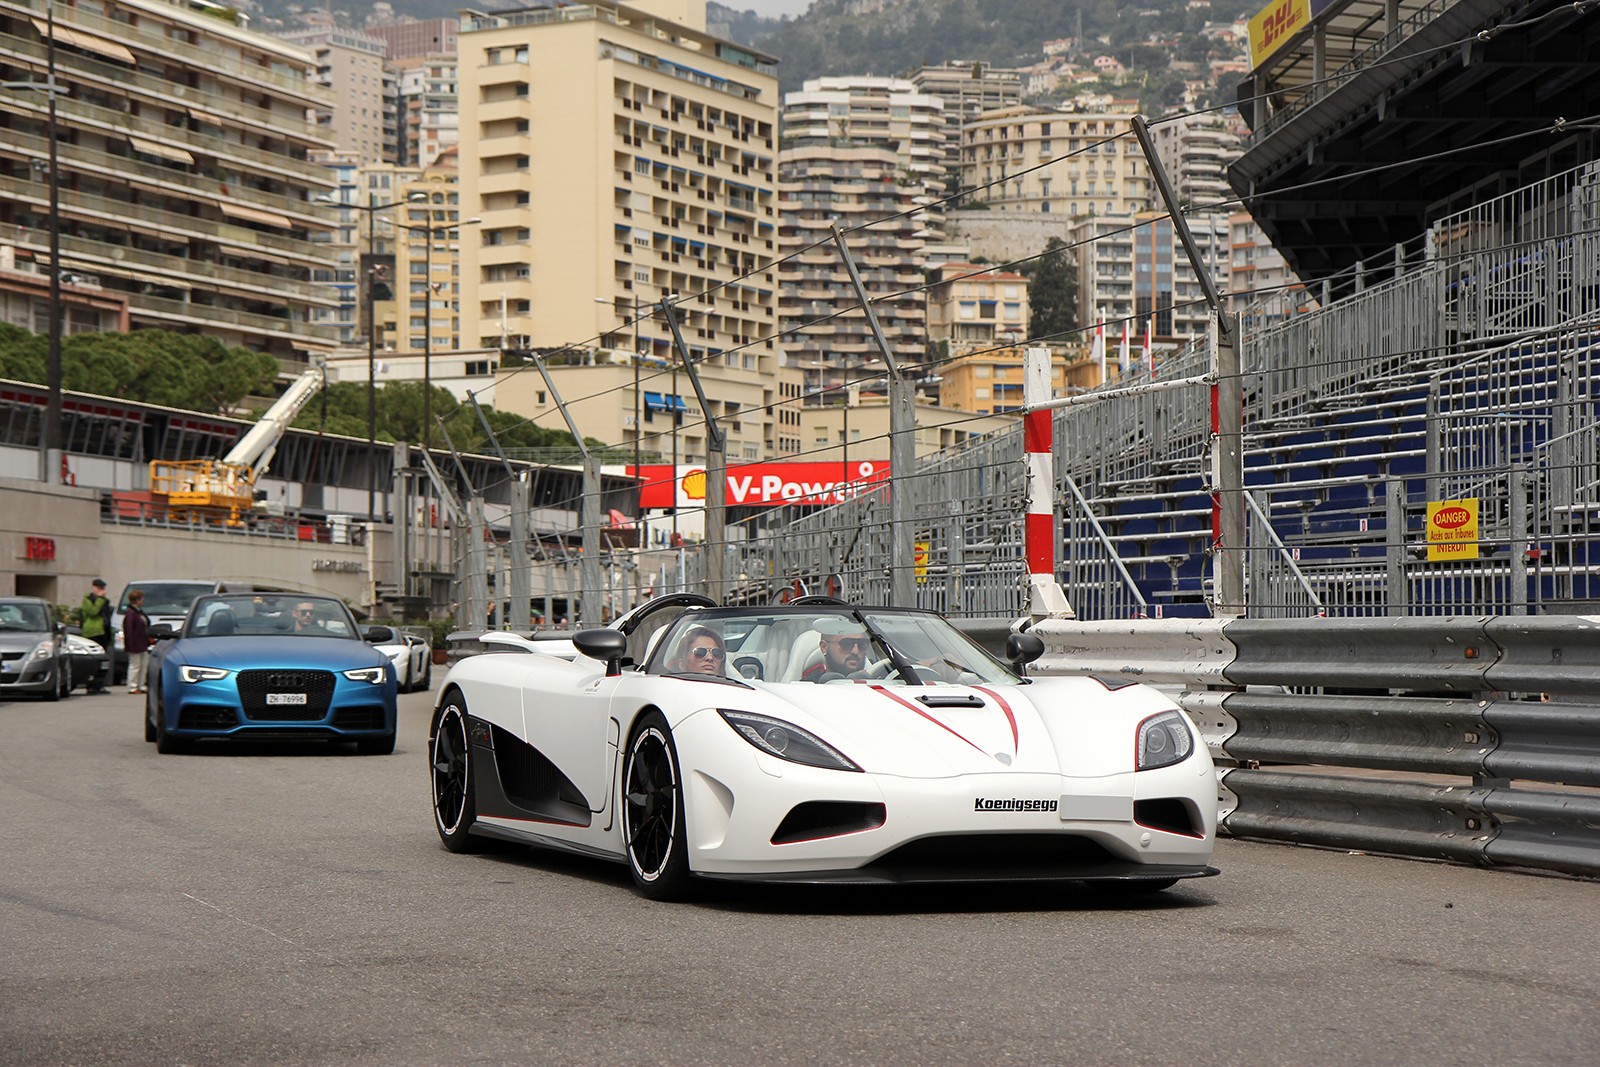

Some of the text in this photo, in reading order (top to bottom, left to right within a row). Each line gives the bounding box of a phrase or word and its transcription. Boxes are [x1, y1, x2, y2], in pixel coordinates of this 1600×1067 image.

[1435, 511, 1467, 525] DANGER
[1430, 530, 1443, 541] Accès
[1455, 528, 1475, 539] Tribunes
[974, 798, 1058, 812] Koenigsegg
